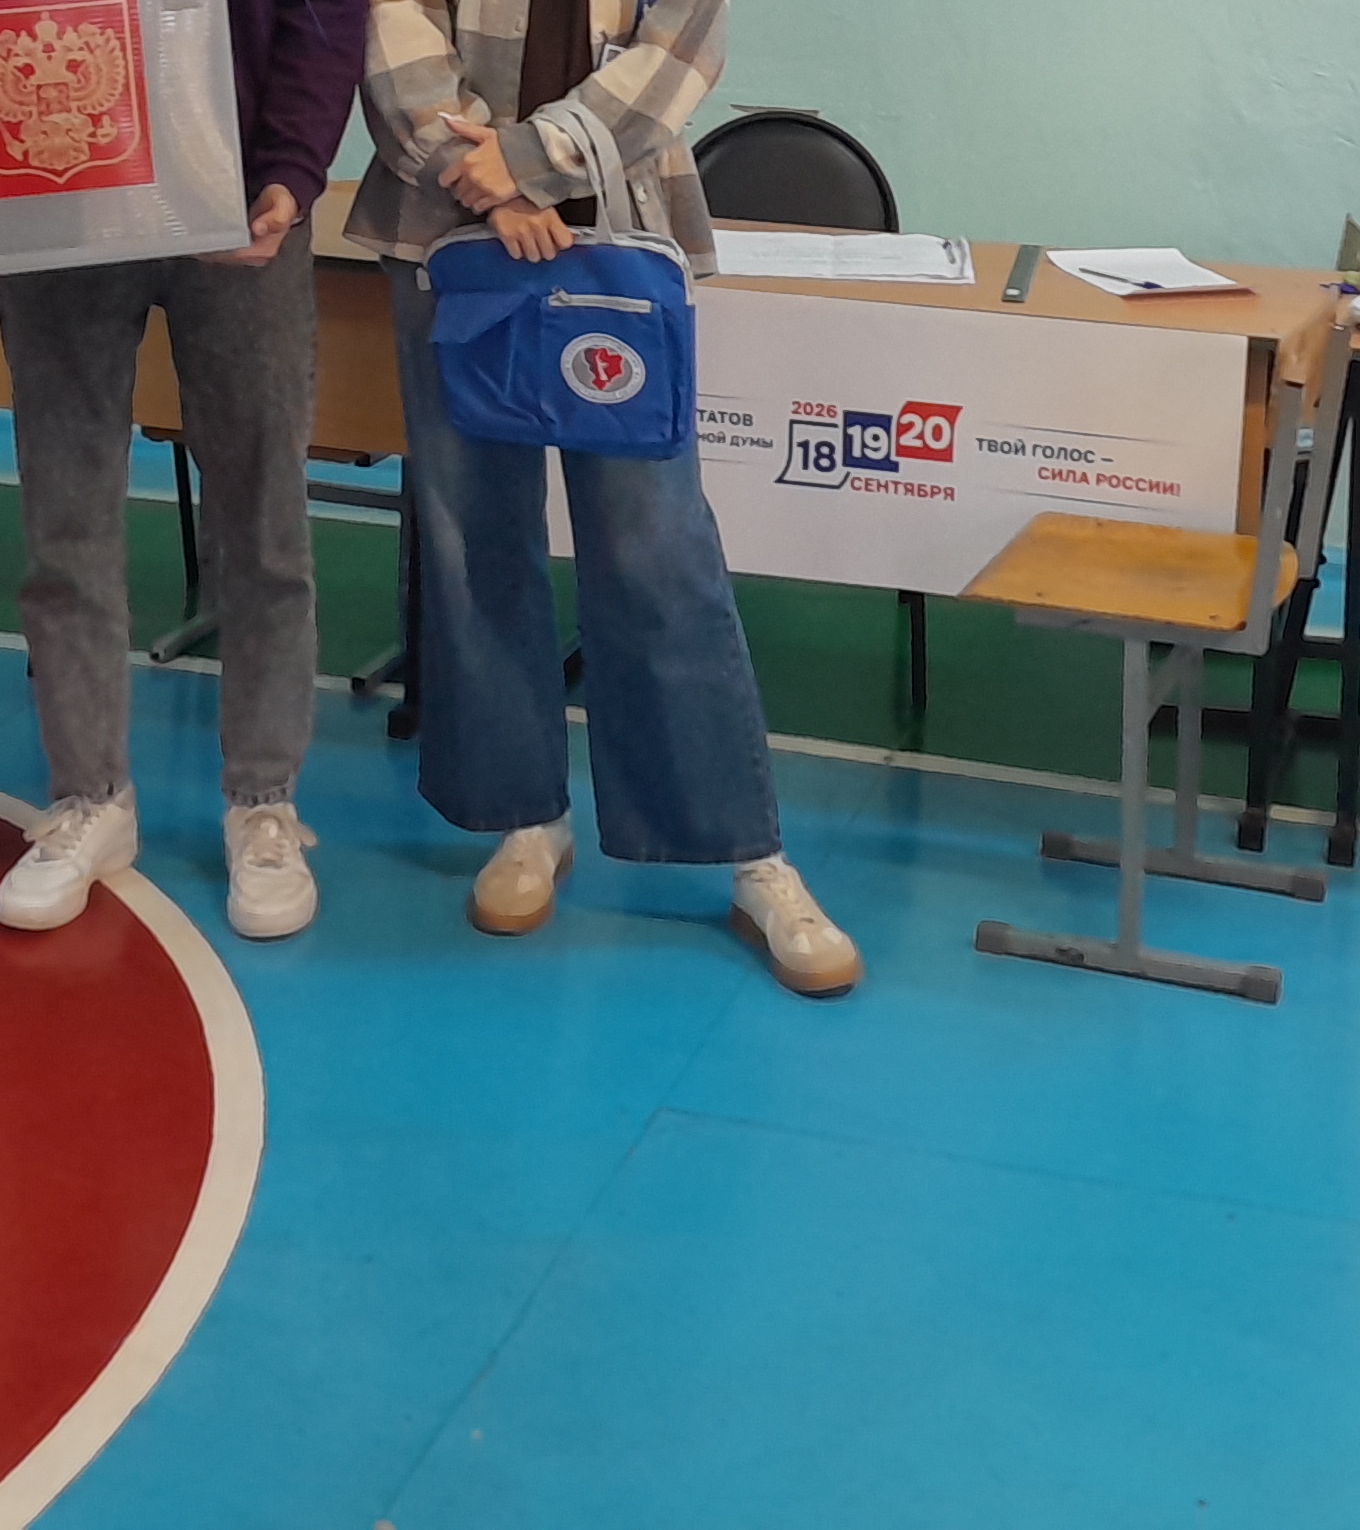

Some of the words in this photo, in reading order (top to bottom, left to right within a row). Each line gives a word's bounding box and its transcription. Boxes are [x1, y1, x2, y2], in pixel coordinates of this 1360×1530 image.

[696, 408, 754, 427] ТАТОВ
[792, 400, 838, 419] 2026
[730, 435, 774, 449] ДУМЫ
[796, 439, 837, 473] 18
[846, 425, 890, 461] 19
[898, 412, 952, 450] 20
[975, 437, 1026, 457] ТВОЙ
[1032, 444, 1096, 464] ГОЛОС
[850, 476, 956, 501] СЕНТЯБРЯ
[1038, 466, 1091, 486] СИЛА
[1096, 473, 1182, 497] РОССИИ!
